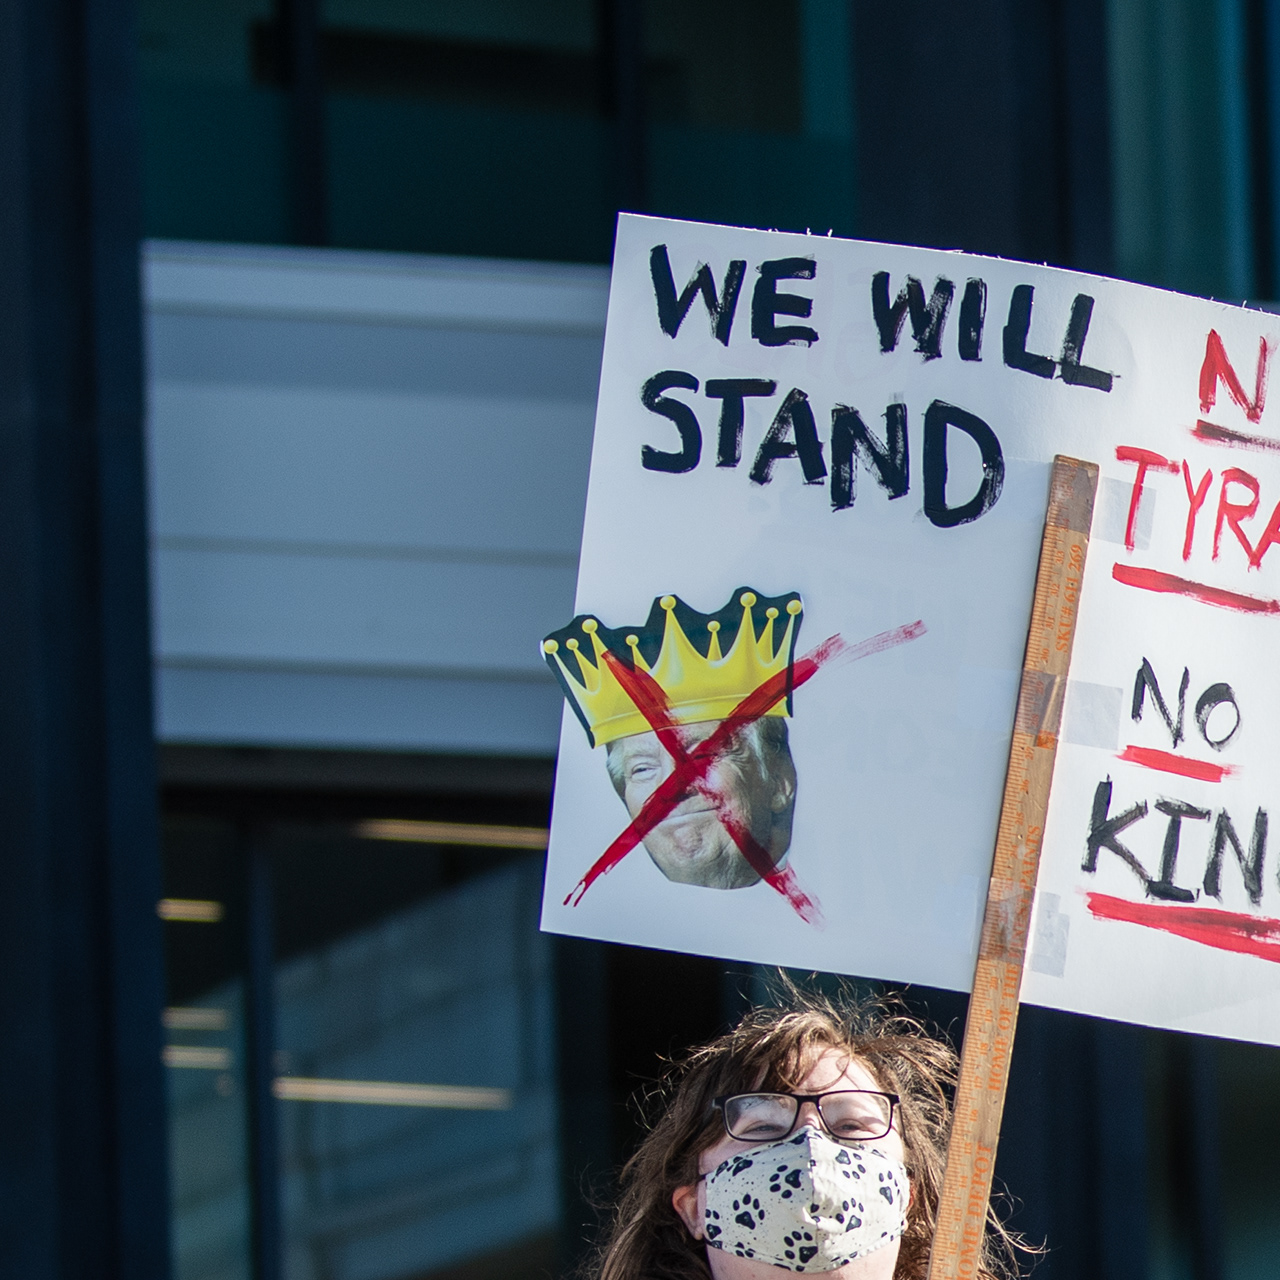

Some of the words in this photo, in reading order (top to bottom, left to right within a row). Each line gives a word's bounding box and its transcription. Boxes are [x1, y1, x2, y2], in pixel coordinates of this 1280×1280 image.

[650, 244, 818, 347] WE
[872, 270, 1117, 391] WILL
[642, 371, 1003, 527] STAND
[1067, 543, 1084, 572] 269
[1062, 575, 1079, 604] 611
[1055, 605, 1075, 654] SKU#
[1131, 657, 1241, 751] NO
[1018, 823, 1042, 892] PAINTS
[1000, 962, 1020, 1002] THE
[996, 1003, 1014, 1032] OF
[987, 1033, 1010, 1093] HOME
[966, 1141, 993, 1219] DEPOT
